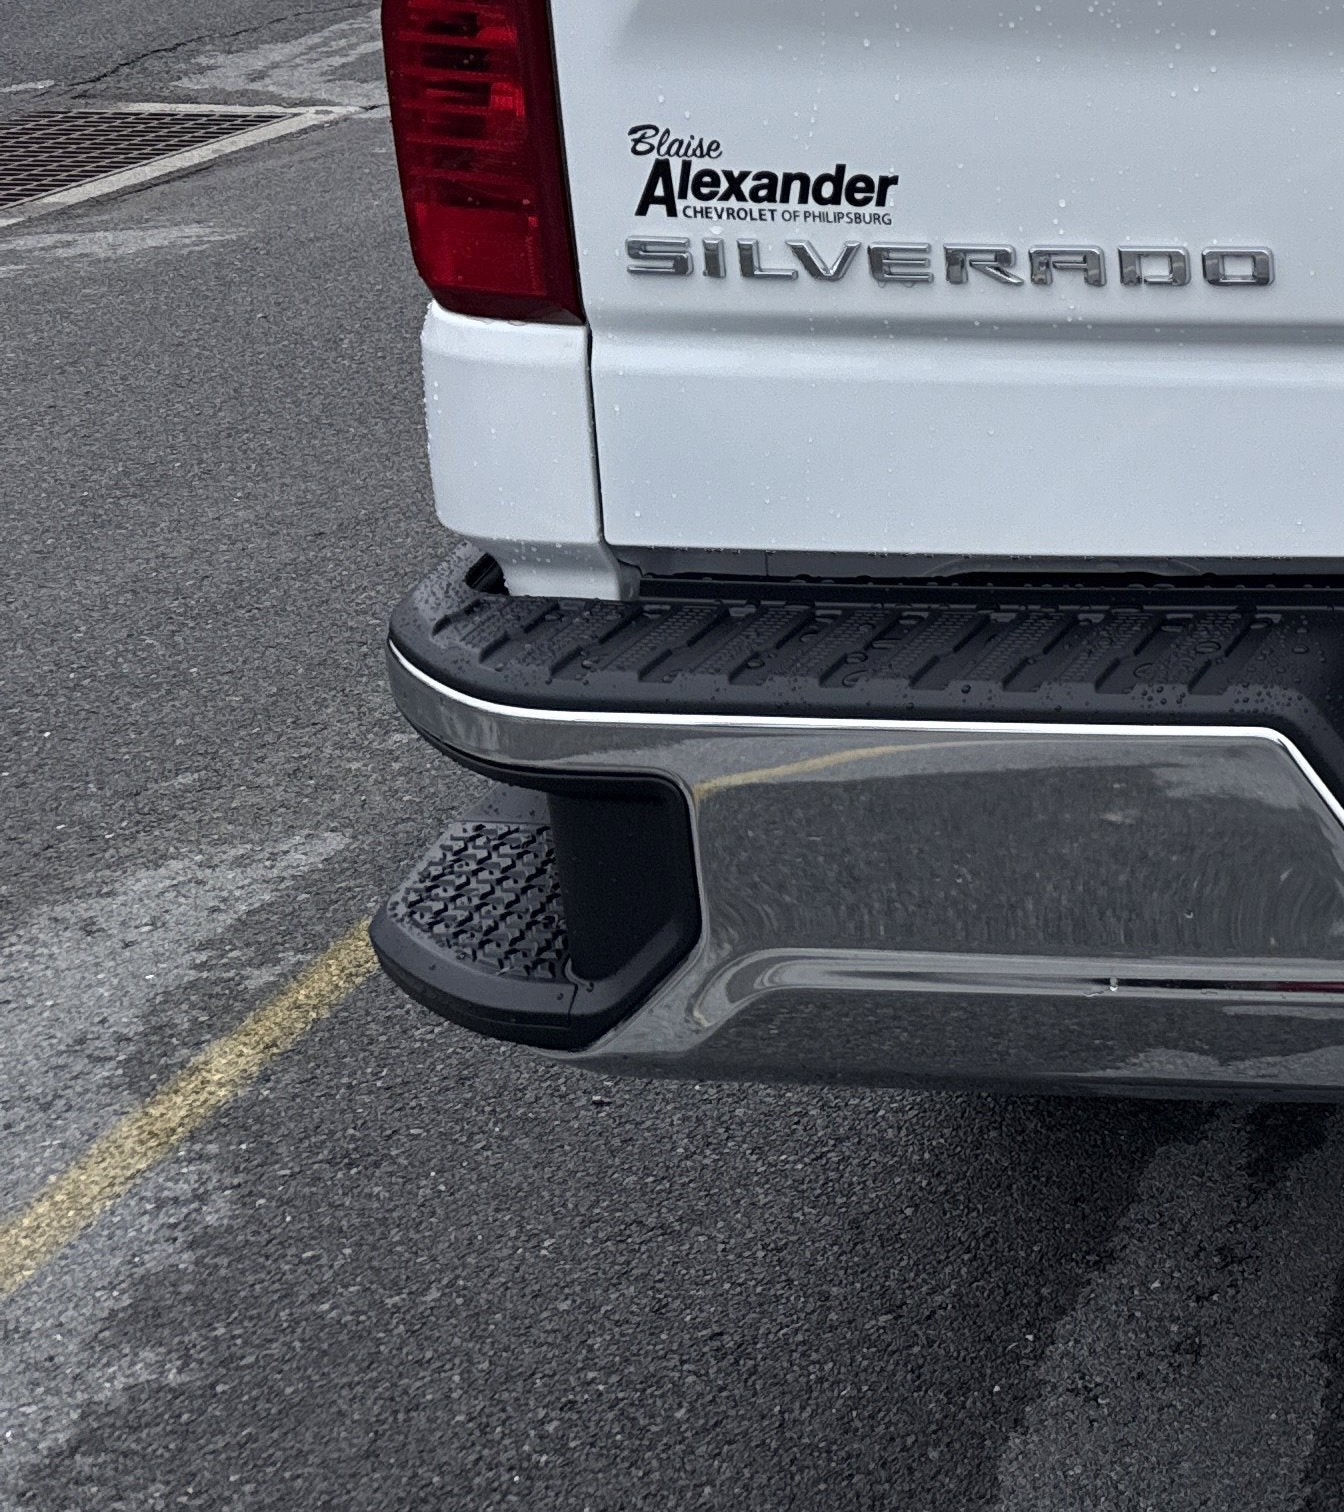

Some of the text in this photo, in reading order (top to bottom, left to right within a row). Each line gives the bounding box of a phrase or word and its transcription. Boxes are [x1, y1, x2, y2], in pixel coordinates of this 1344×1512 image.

[628, 124, 723, 159] Blaise
[634, 158, 899, 218] Alexander
[682, 205, 893, 226] CHEVROLET OF PHILIPSBURG
[625, 235, 1274, 288] SILVERADO
